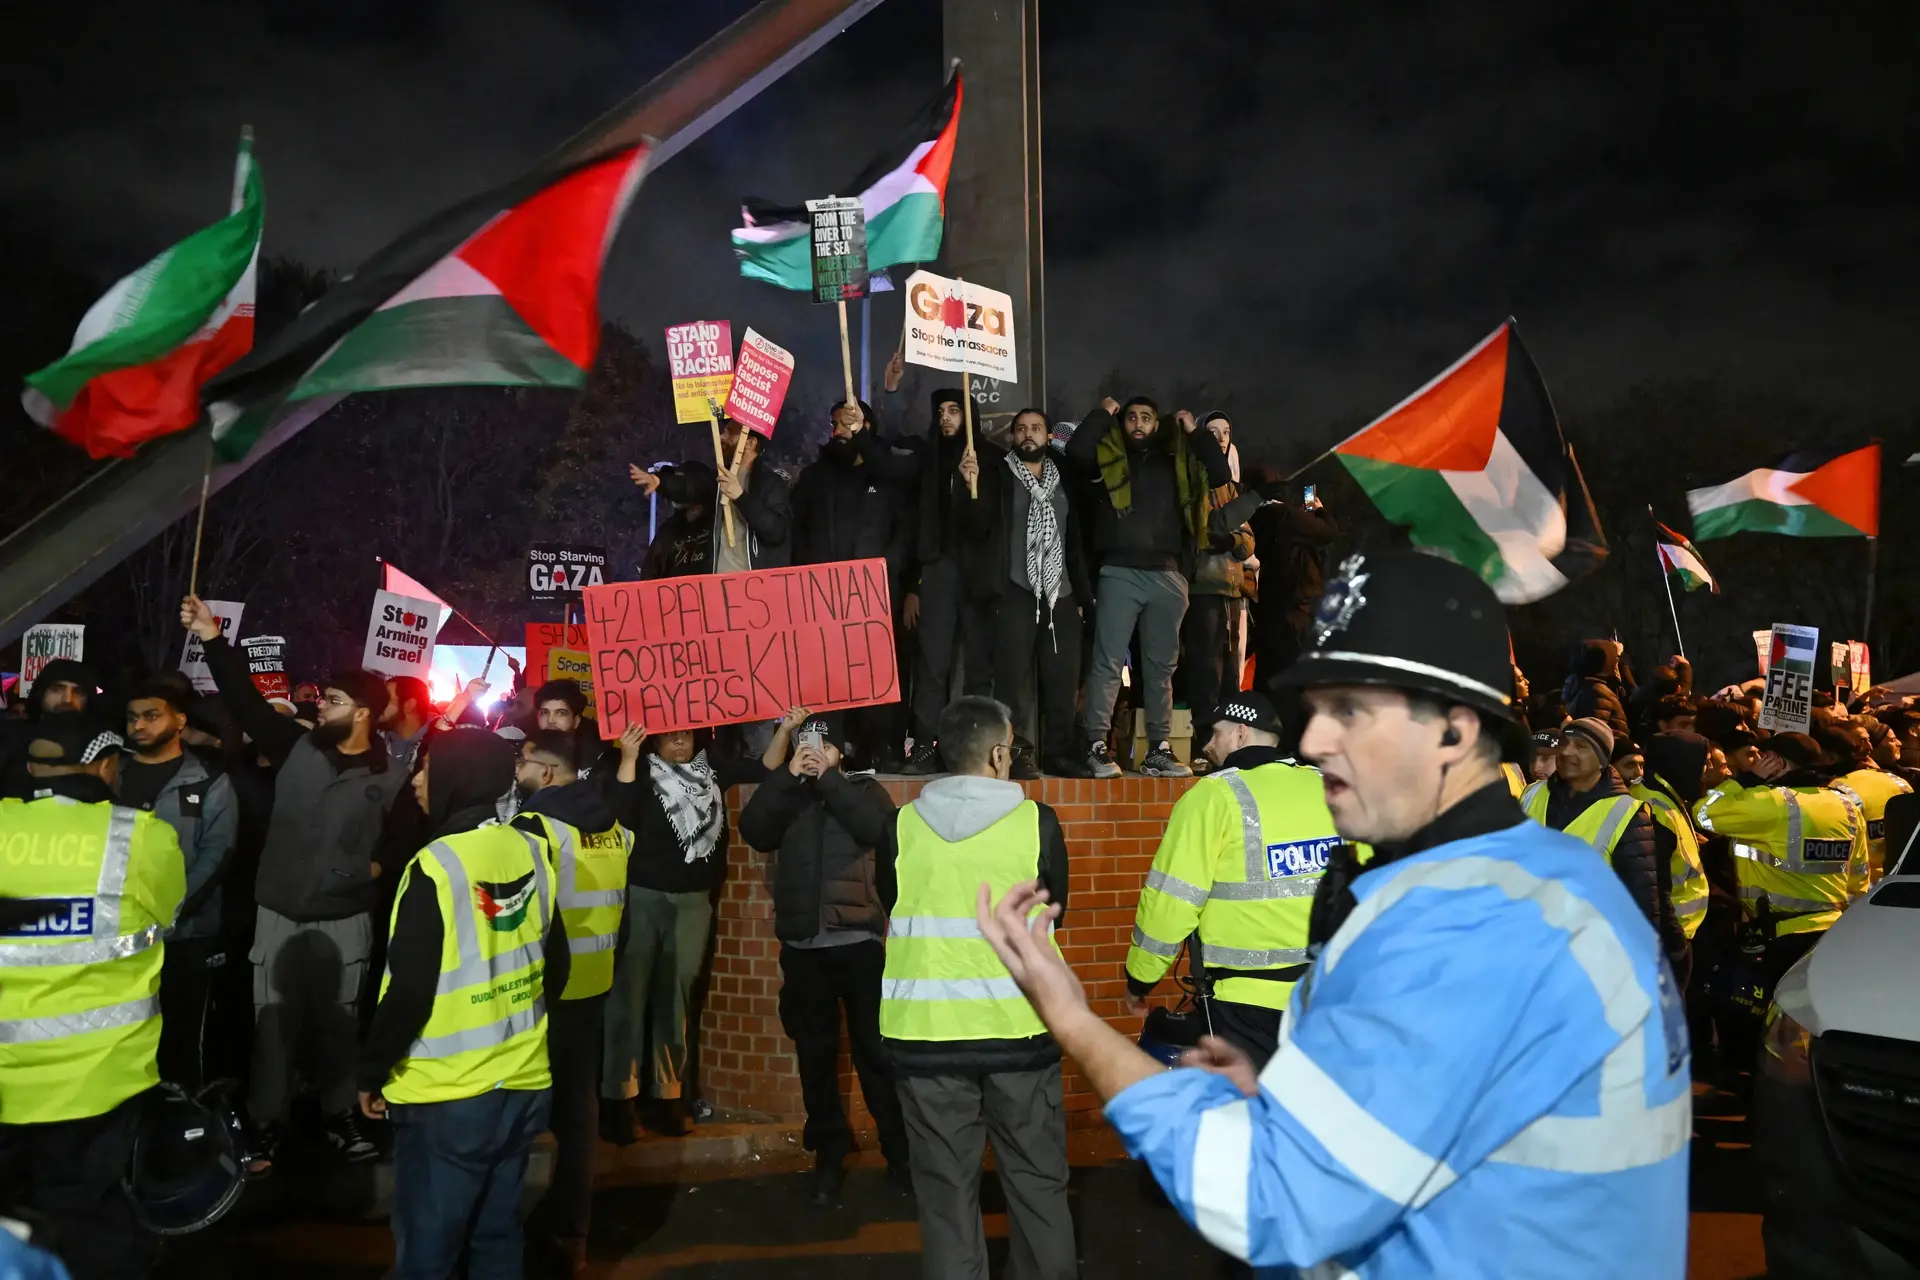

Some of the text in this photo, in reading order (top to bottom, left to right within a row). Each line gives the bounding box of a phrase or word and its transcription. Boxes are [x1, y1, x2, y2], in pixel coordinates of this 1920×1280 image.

[814, 211, 857, 228] FROM THE
[814, 226, 853, 243] RIVER TO
[815, 241, 851, 257] THE SEA
[816, 255, 862, 273] PALESTINE
[818, 269, 852, 287] WILL BE
[668, 324, 720, 344] STAND
[911, 328, 1008, 358] Stop the massacre
[671, 340, 718, 360] UP TO
[673, 355, 732, 376] RACISM
[741, 351, 779, 382] Oppose
[676, 382, 686, 390] No
[687, 381, 694, 389] to
[737, 364, 772, 393] fascist
[677, 391, 690, 400] and
[735, 377, 770, 408] Tommy
[970, 391, 1000, 404] CC
[730, 390, 776, 426] Robinson
[530, 549, 605, 566] Stop Starving
[529, 563, 604, 591] GAZA
[589, 562, 890, 645] 421 PALESTINIAN
[376, 624, 429, 649] Arming
[247, 645, 281, 658] FREEDOM
[376, 641, 423, 664] Israel
[248, 661, 284, 673] PALESTINE
[599, 636, 736, 688] FOOTBALL
[745, 619, 896, 715] KILLED
[604, 675, 749, 734] PLAYERS
[1805, 842, 1850, 858] POLICE
[511, 991, 532, 1004] GROU
